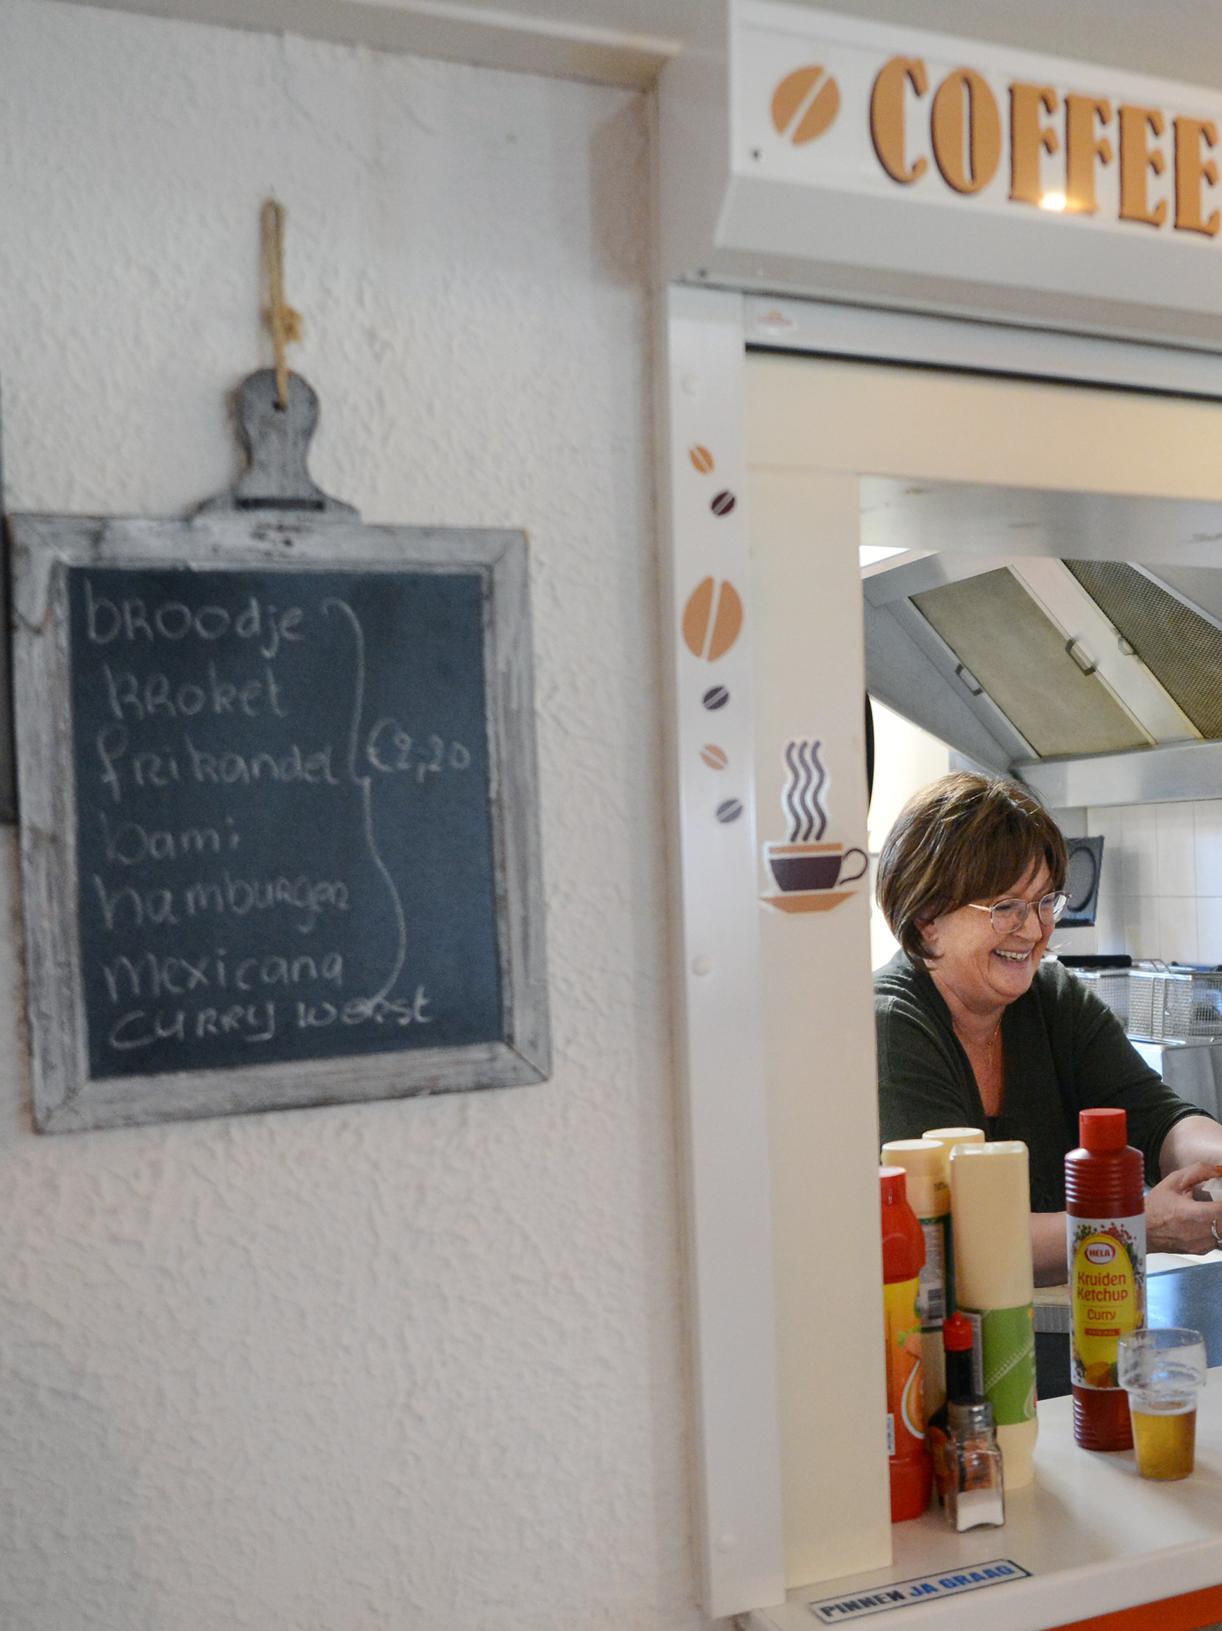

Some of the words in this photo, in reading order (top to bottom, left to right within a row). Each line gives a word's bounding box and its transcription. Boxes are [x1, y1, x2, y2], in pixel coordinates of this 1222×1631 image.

[868, 54, 1221, 237] COFFEE
[99, 808, 241, 867] bami
[1089, 1248, 1111, 1258] HELA
[1077, 1271, 1127, 1288] Kruiden
[1077, 1286, 1129, 1303] Ketchup
[1087, 1308, 1117, 1321] Curry
[819, 1589, 906, 1618] PINNEN
[909, 1583, 939, 1598] JA
